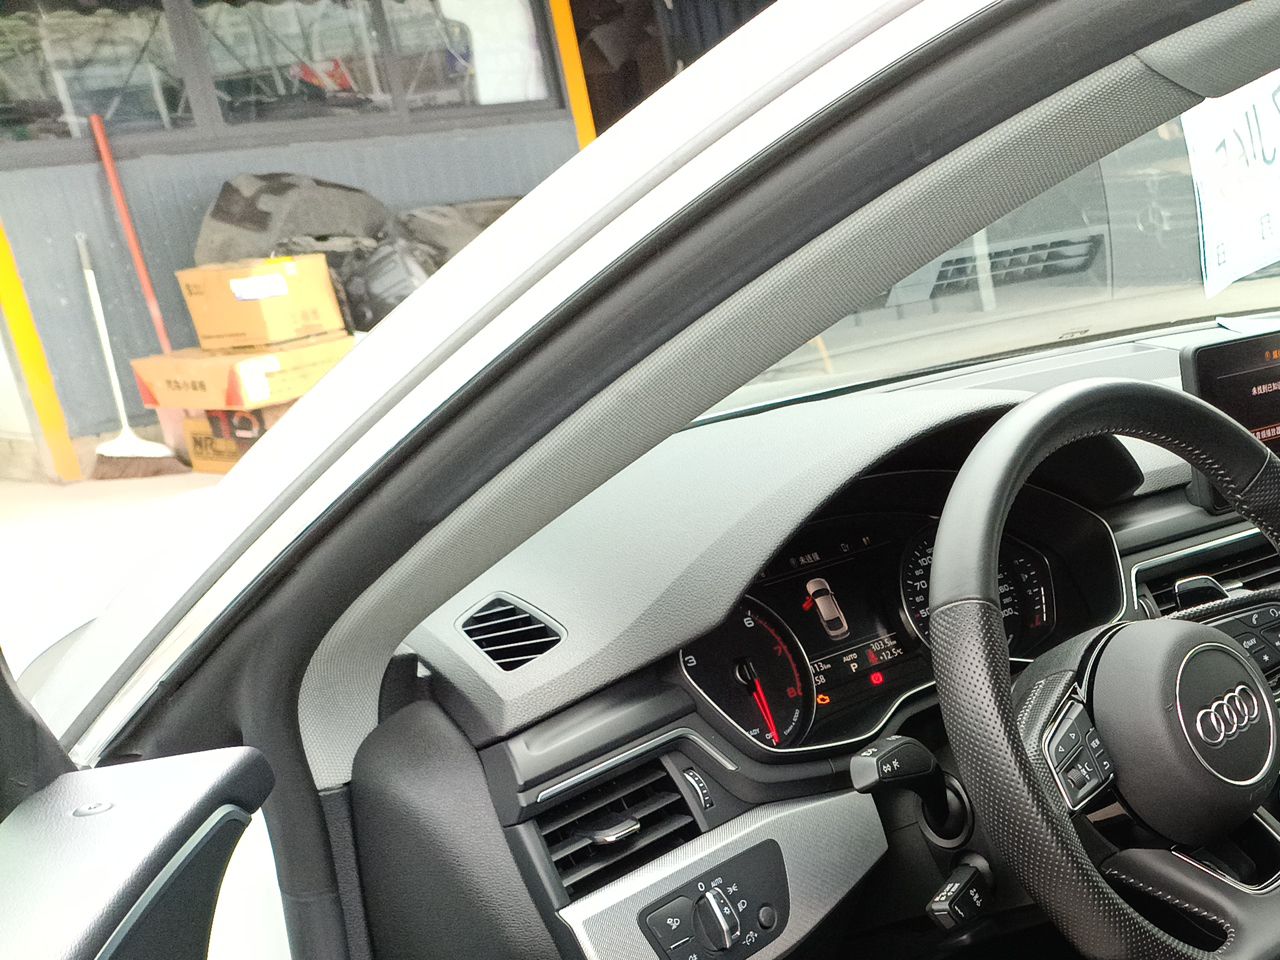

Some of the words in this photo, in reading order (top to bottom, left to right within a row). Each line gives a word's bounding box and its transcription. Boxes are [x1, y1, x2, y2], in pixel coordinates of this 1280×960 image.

[914, 580, 927, 591] 70
[743, 617, 755, 628] 6
[684, 655, 697, 667] 3
[843, 653, 858, 663] AUTO
[850, 663, 858, 673] P
[710, 876, 723, 888] AUTO
